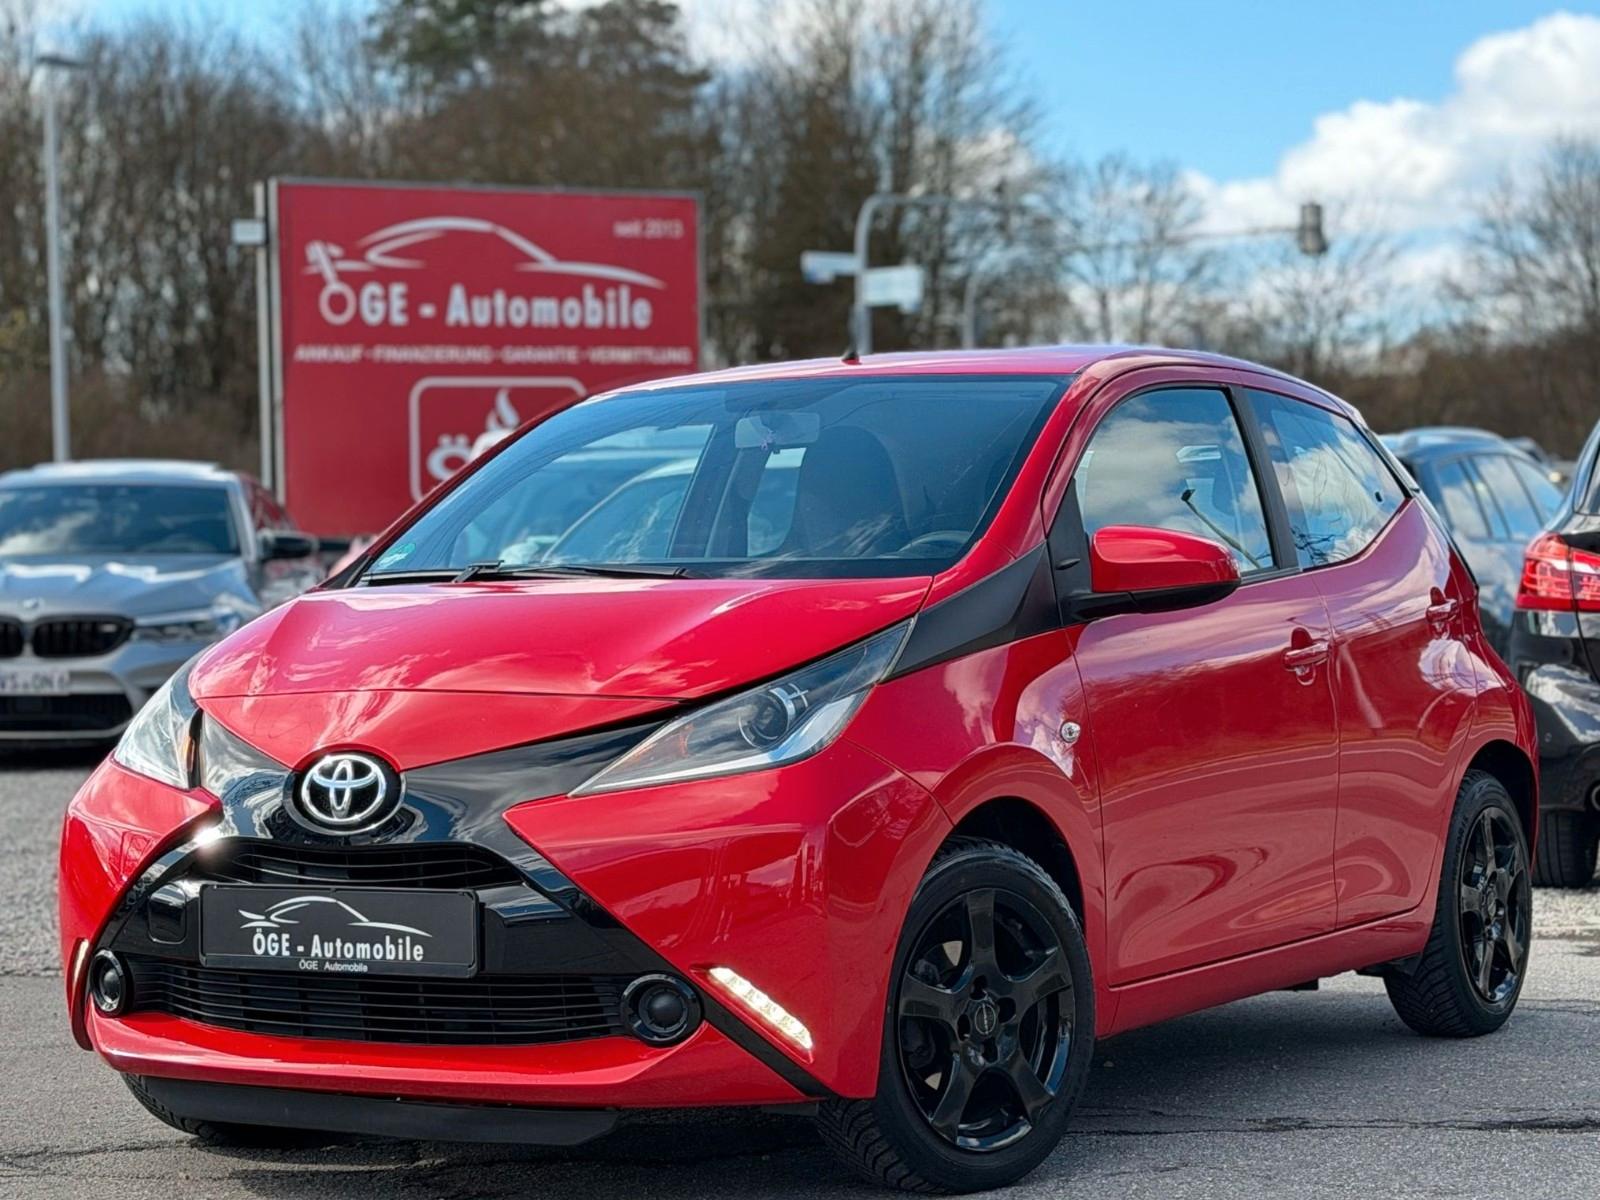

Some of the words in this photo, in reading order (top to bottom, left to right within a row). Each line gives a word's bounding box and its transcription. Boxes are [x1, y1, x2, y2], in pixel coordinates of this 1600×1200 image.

[446, 283, 653, 328] Automobile
[252, 928, 290, 956] ÖGE
[310, 934, 424, 961] Automobile
[299, 959, 318, 971] ÖGE
[324, 962, 368, 973] Automobile
